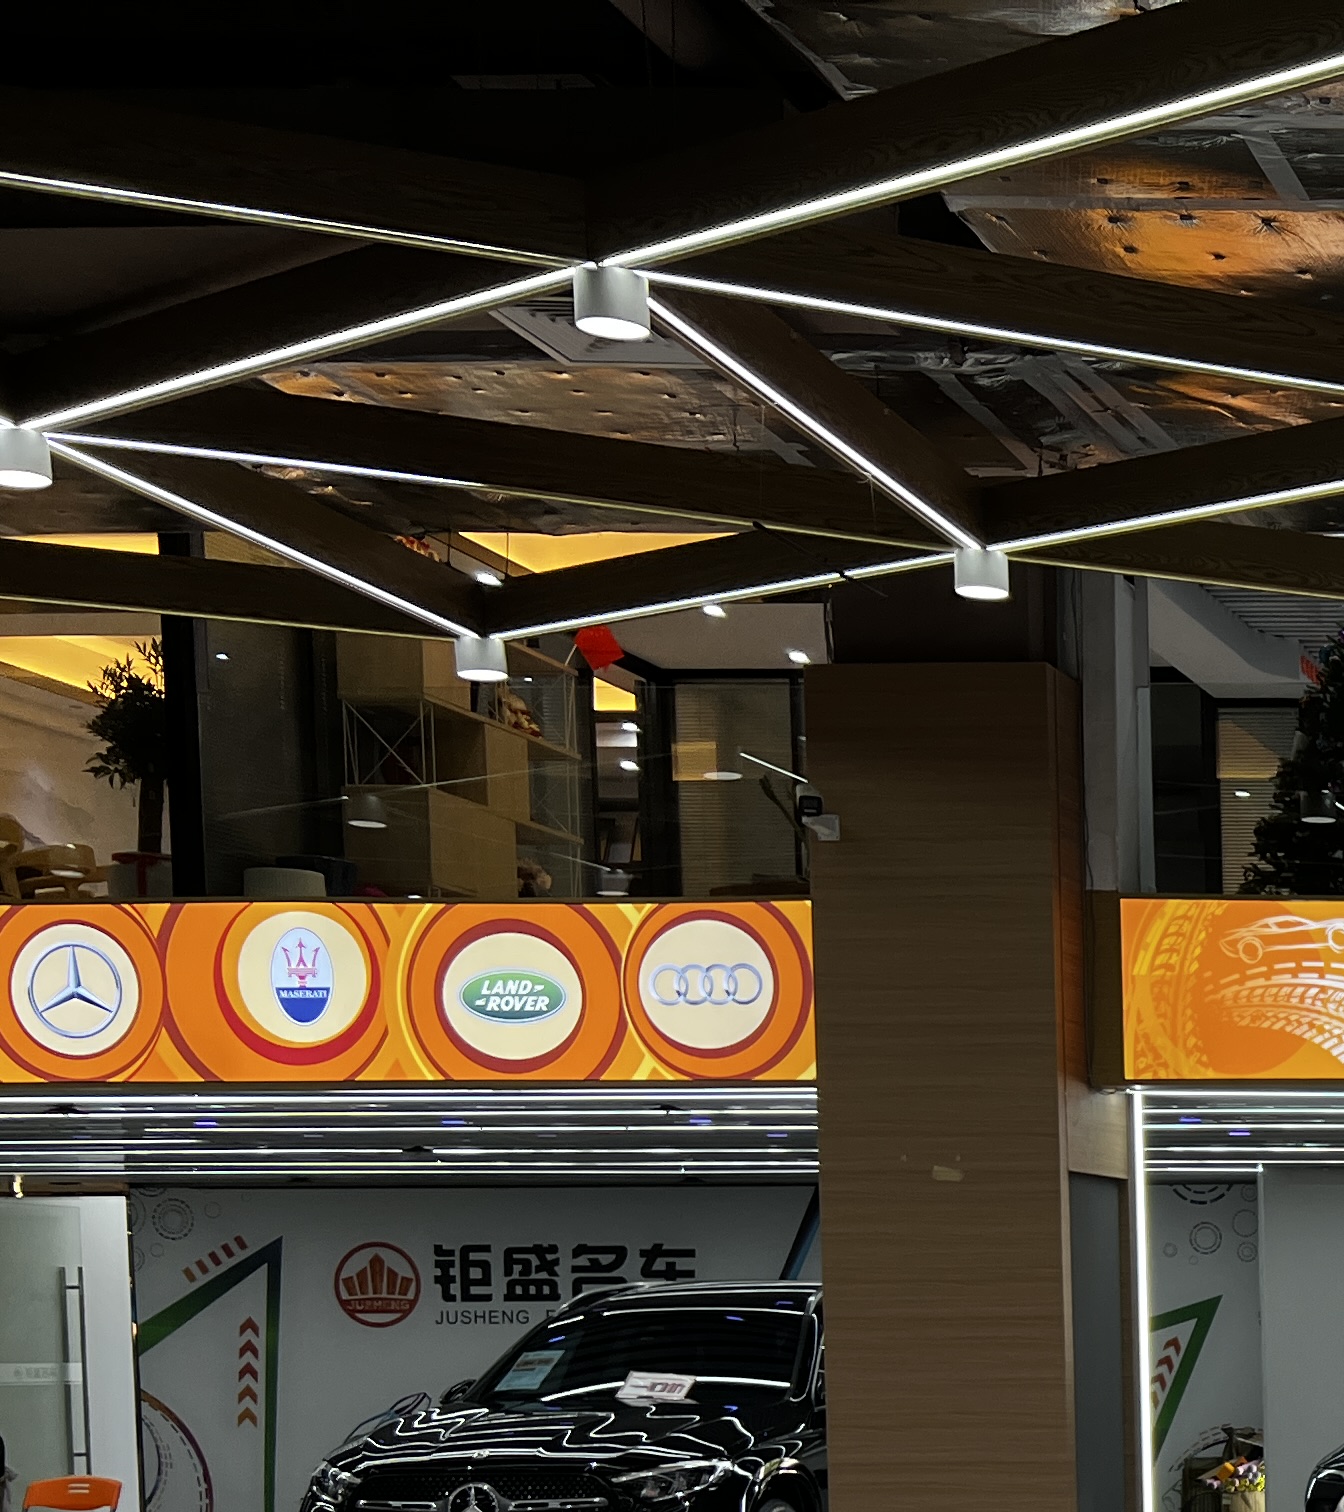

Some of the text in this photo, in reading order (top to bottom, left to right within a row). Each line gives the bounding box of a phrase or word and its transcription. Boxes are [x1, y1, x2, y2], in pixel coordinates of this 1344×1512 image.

[279, 988, 328, 999] MASERATI
[480, 979, 531, 995] LAND
[486, 995, 551, 1012] ROVER
[433, 1243, 696, 1303] 钜盛名车
[435, 1309, 530, 1324] JUSHENG
